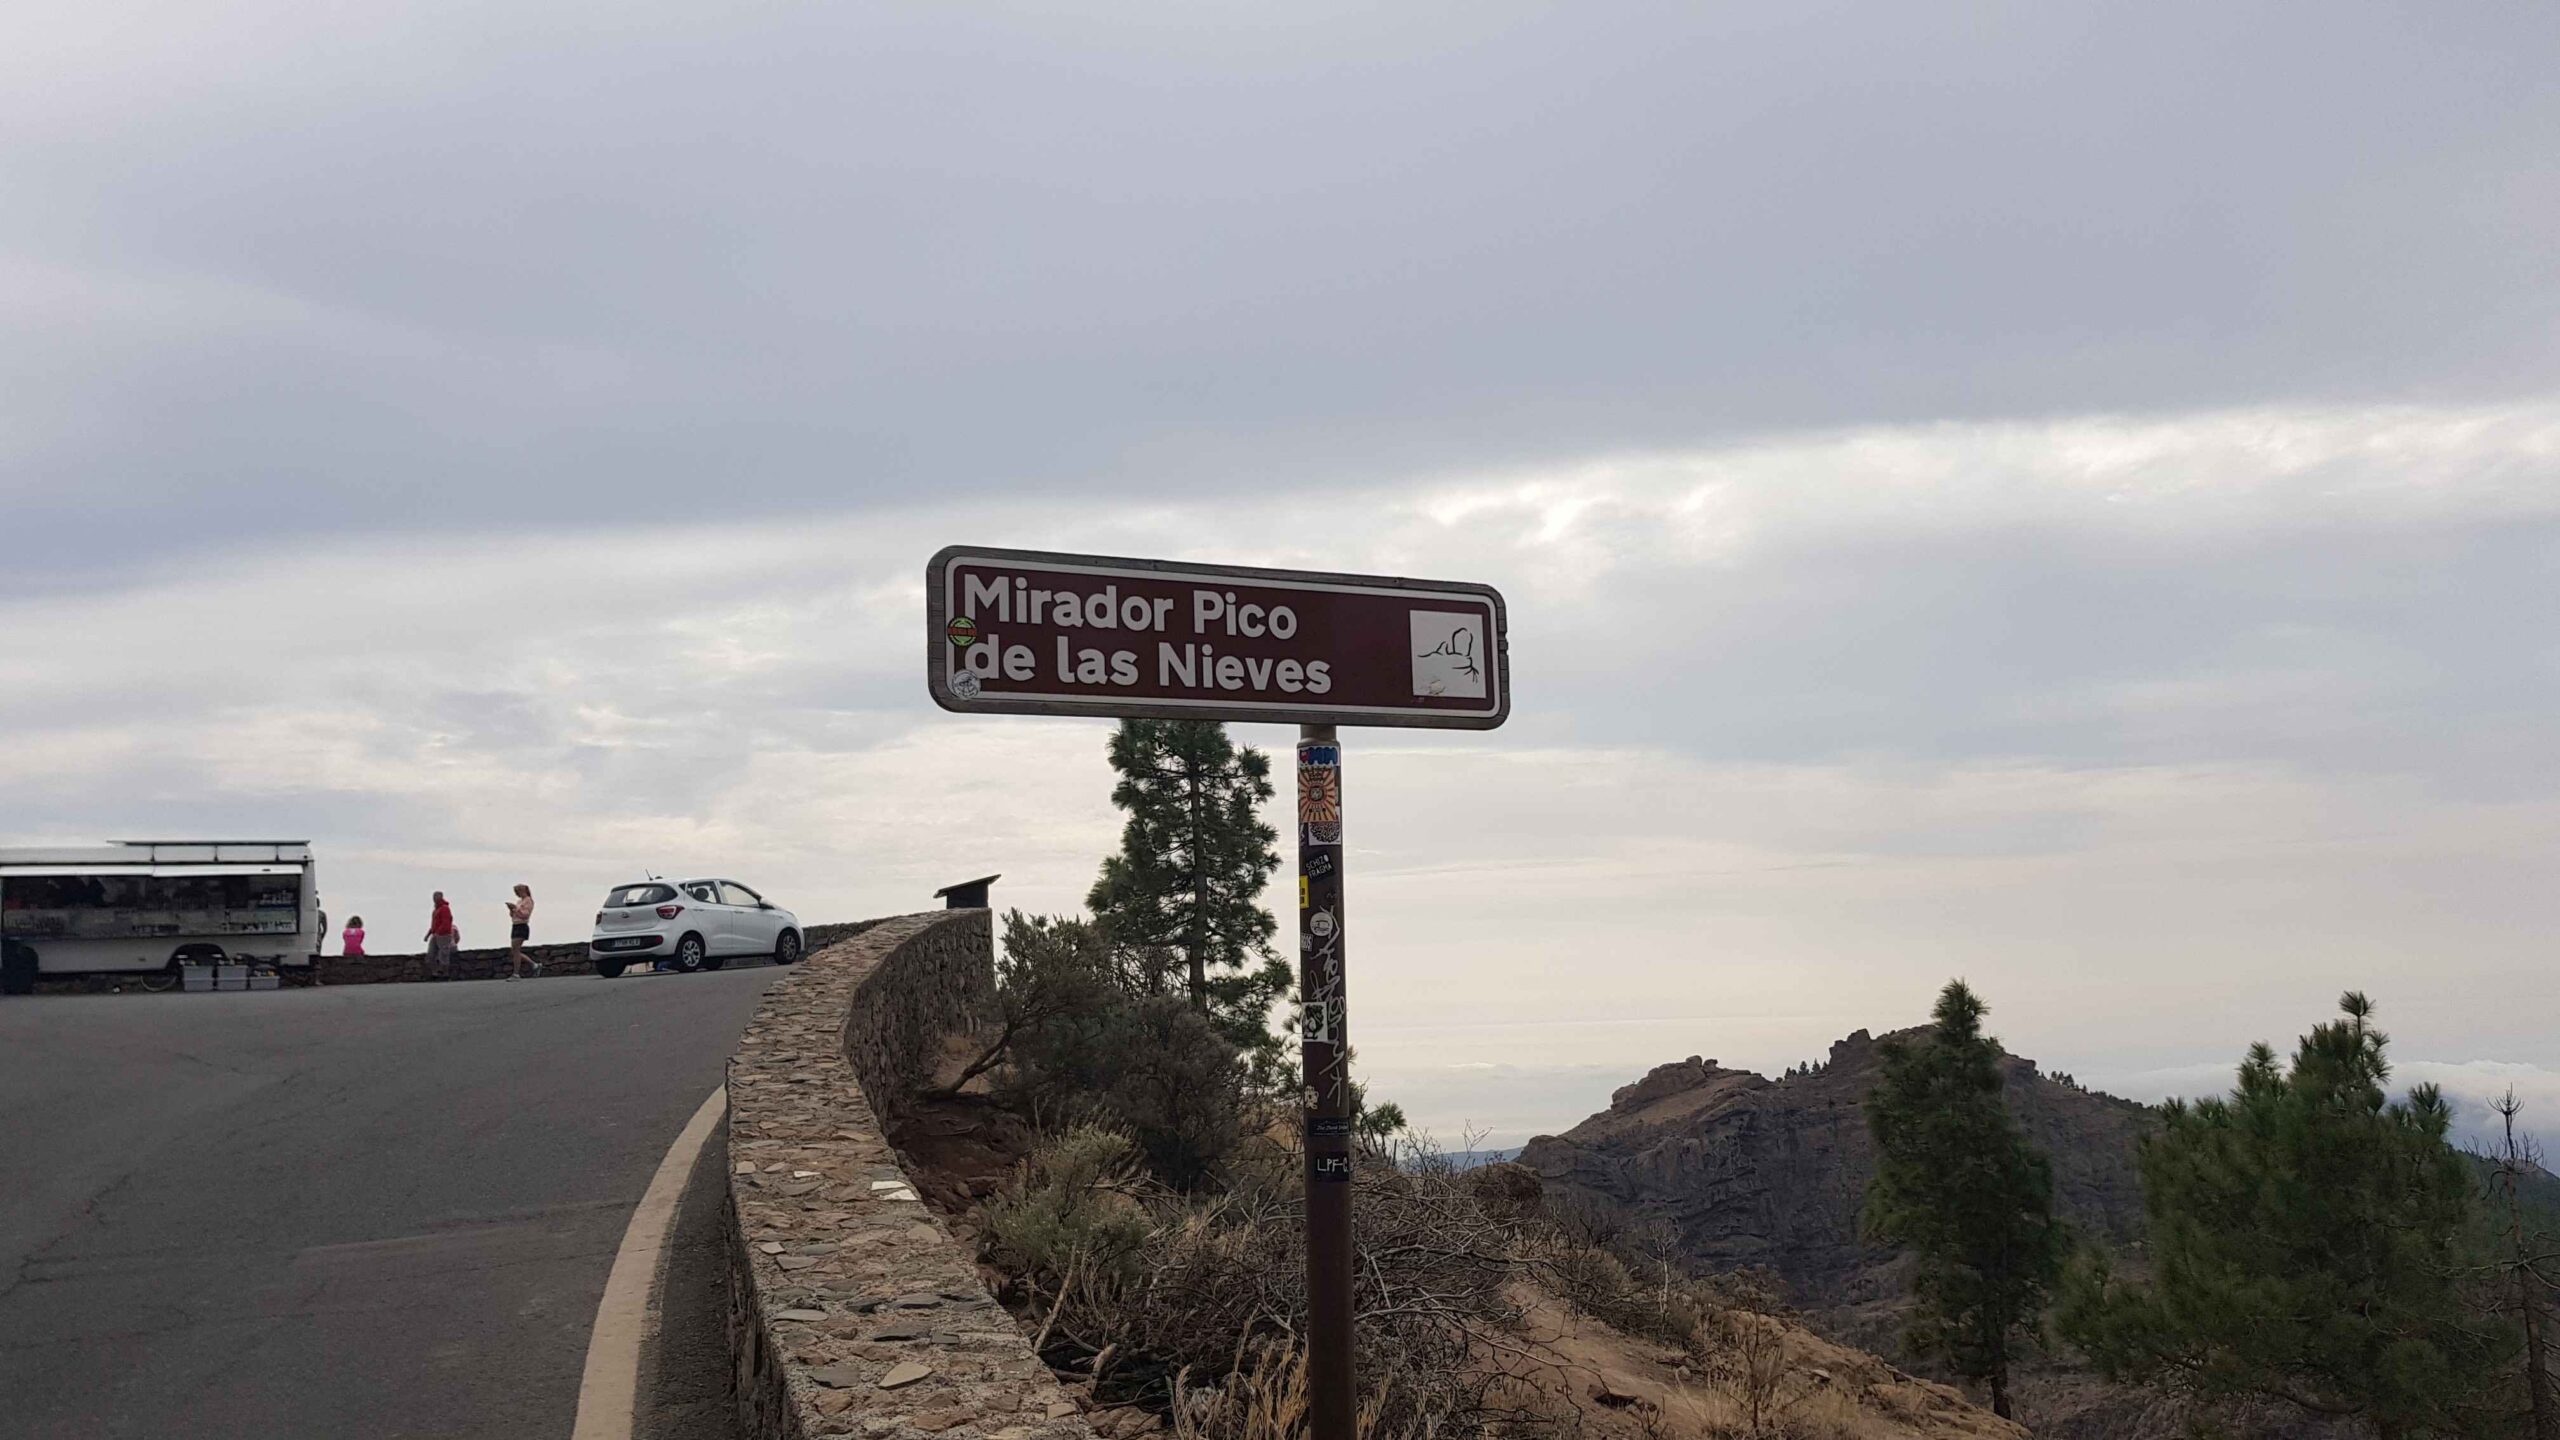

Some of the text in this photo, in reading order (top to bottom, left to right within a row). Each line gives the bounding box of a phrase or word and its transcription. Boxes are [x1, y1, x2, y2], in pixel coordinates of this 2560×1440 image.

[963, 573, 1297, 640] Mirador Pico
[964, 633, 1331, 694] de las Nieves
